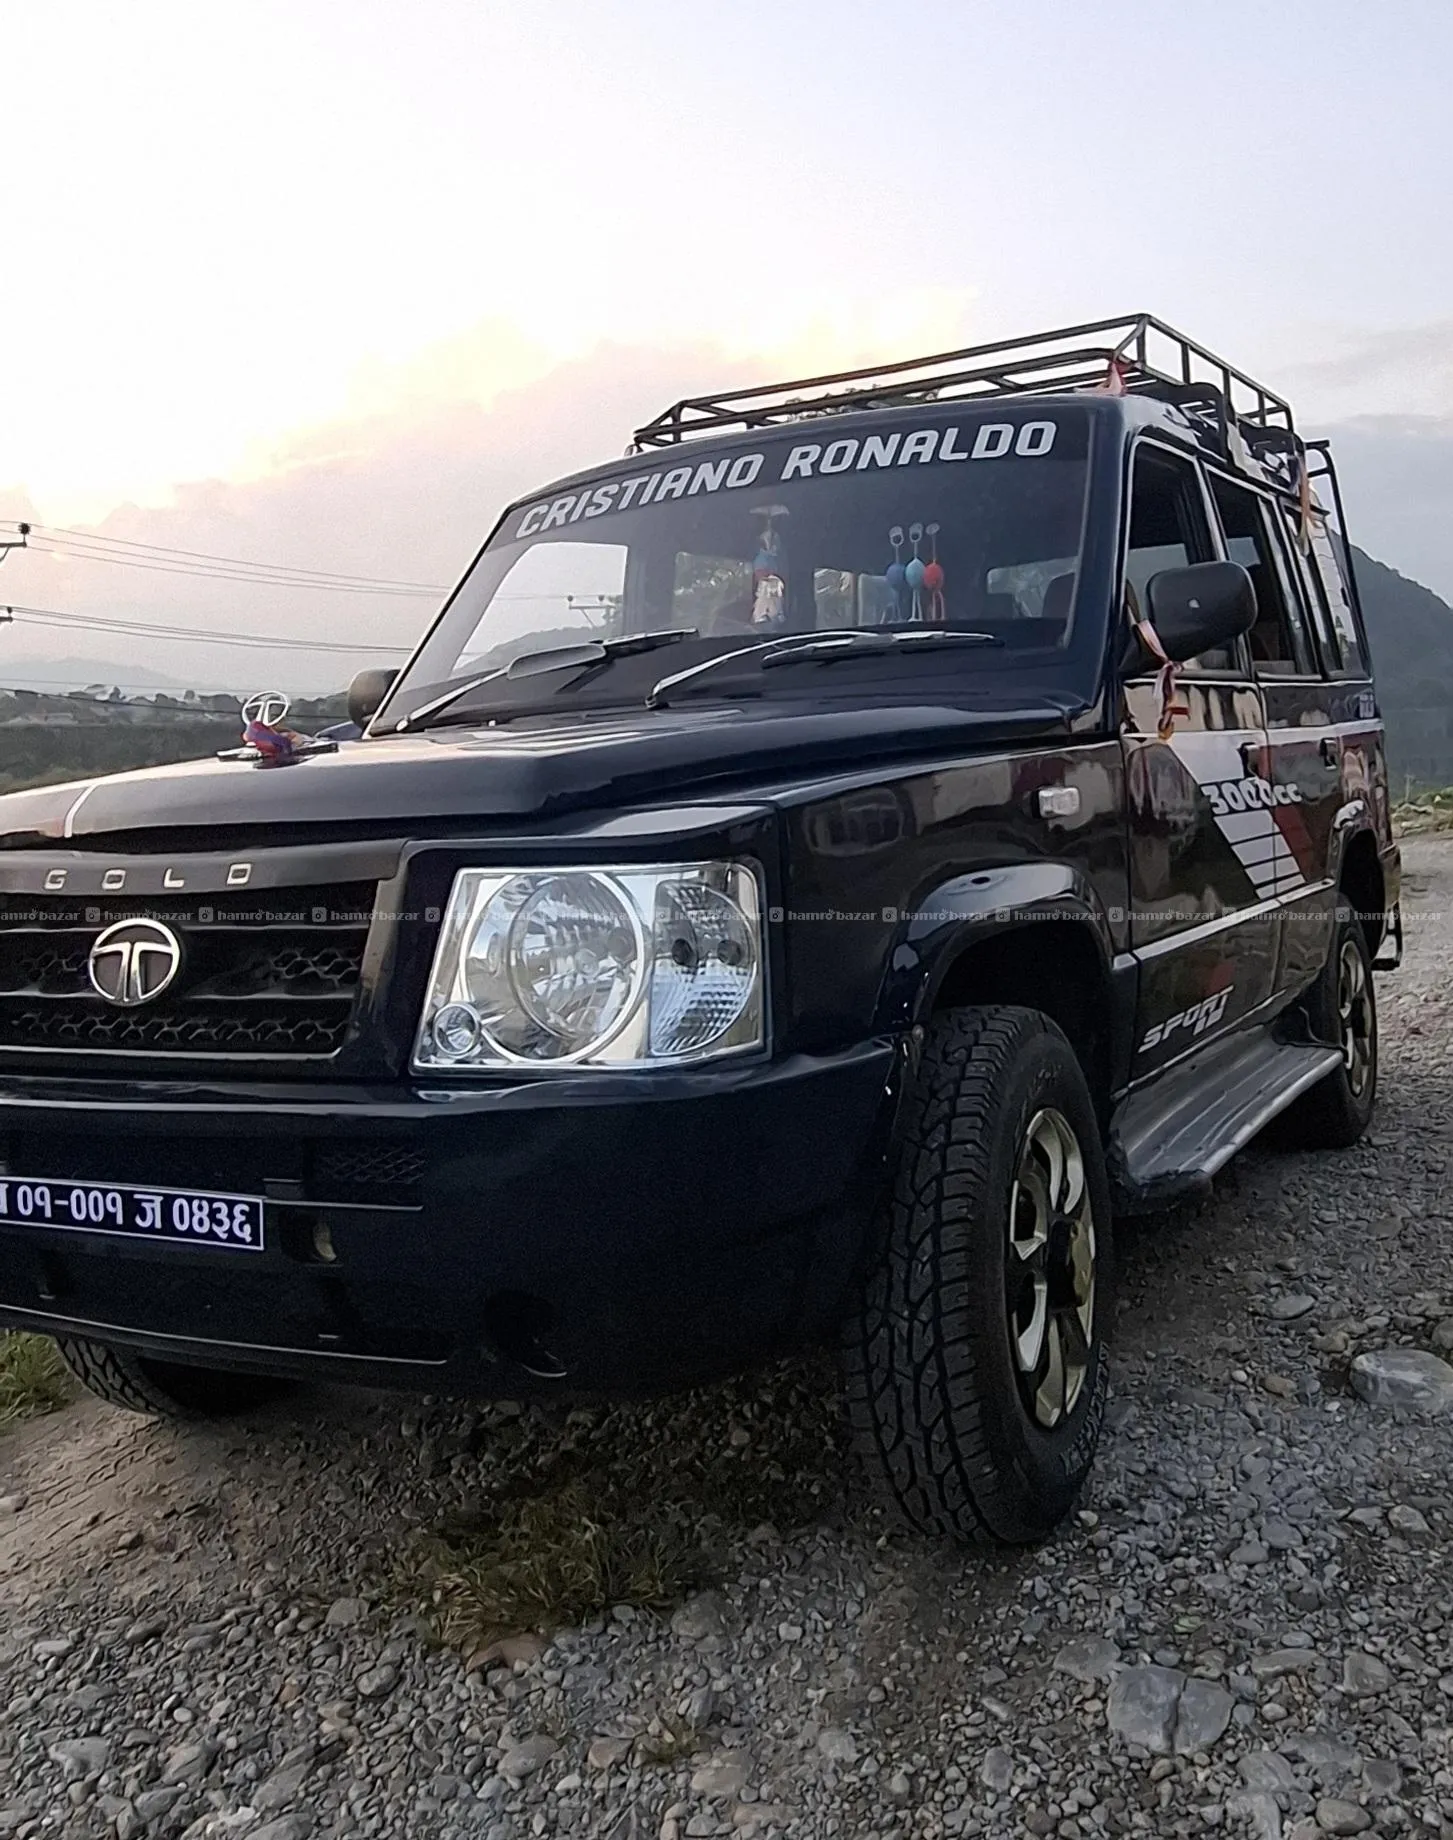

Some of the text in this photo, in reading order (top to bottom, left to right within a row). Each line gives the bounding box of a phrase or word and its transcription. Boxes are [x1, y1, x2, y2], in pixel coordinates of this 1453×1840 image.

[515, 421, 1058, 539] CRISTIANO RONALDO
[133, 1193, 163, 1229] ज
[172, 1197, 252, 1243] ०४३६
